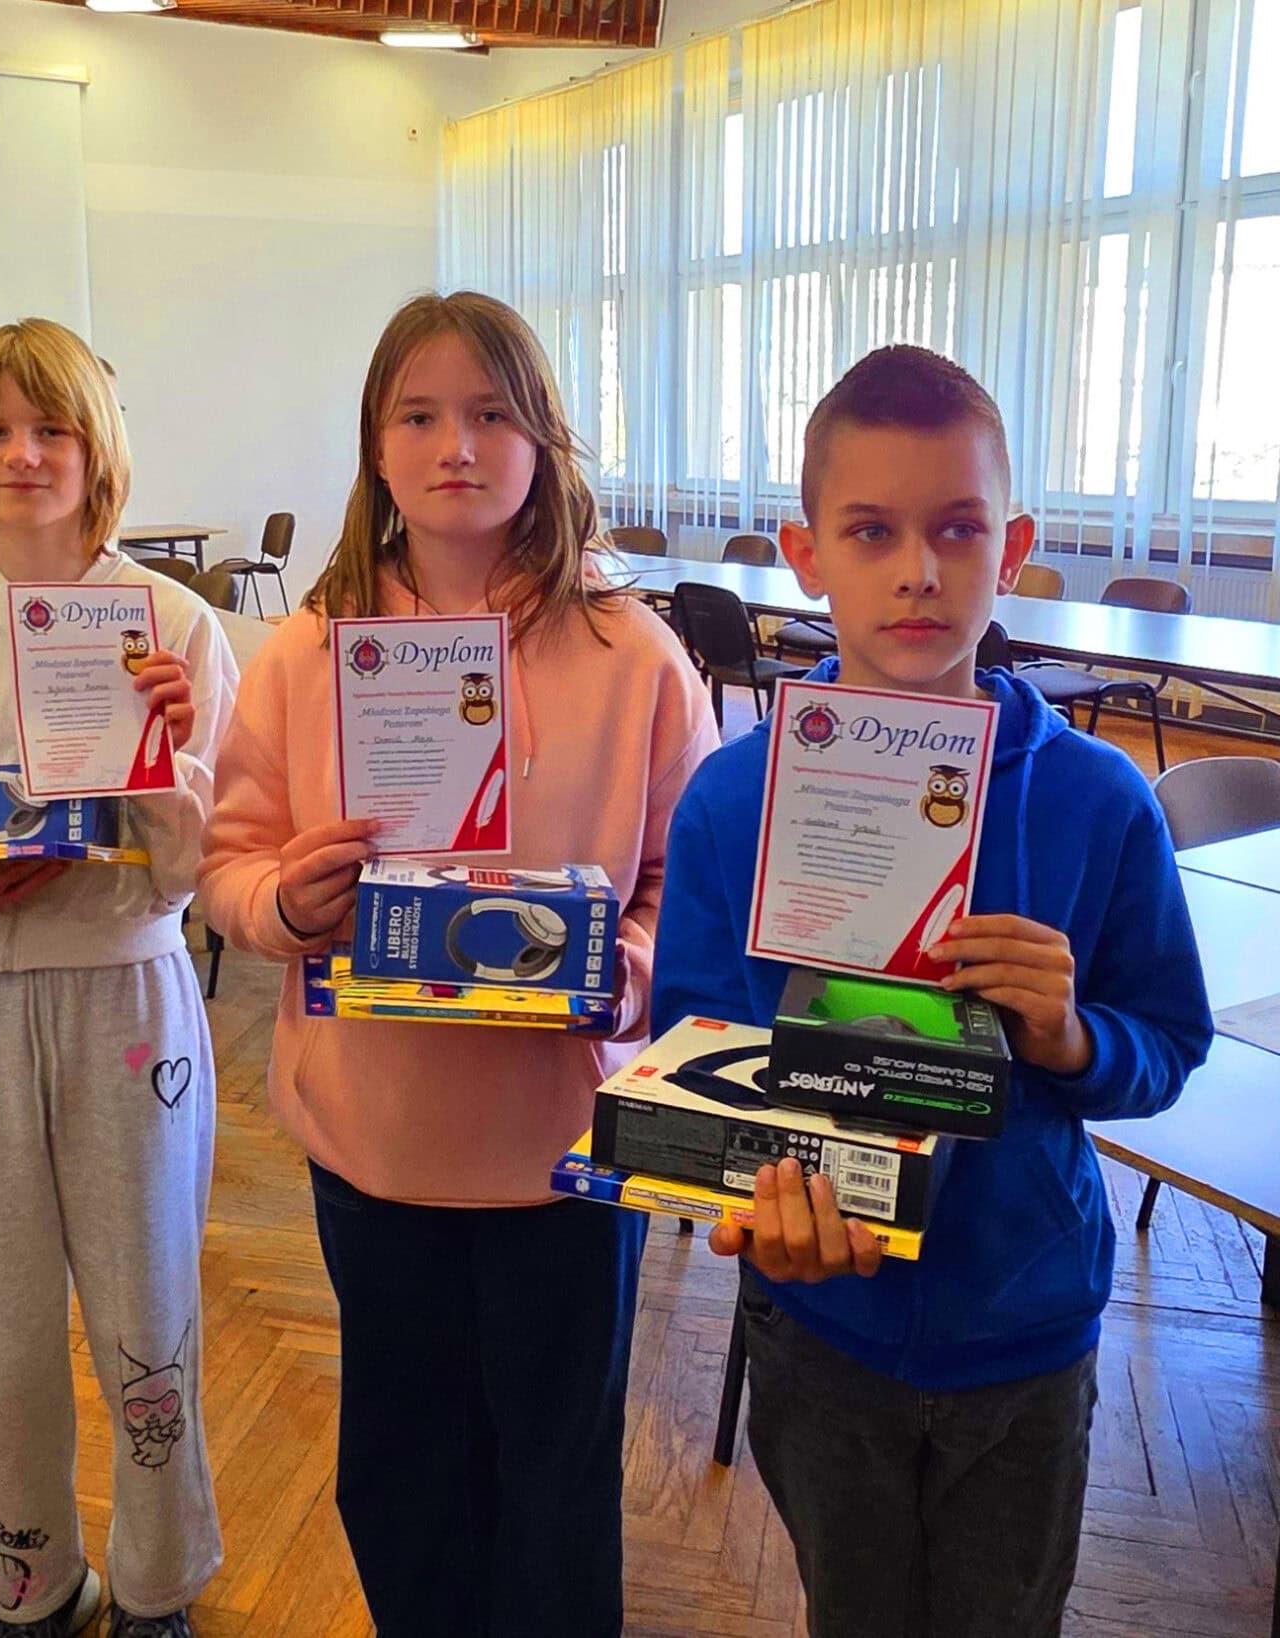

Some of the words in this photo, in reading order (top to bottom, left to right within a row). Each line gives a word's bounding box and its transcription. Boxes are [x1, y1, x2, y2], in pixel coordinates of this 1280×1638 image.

[61, 599, 146, 629] Dyplom
[393, 636, 495, 673] Dyplom
[849, 715, 977, 758] Dyplom
[386, 906, 403, 959] LIBERO
[863, 1065, 913, 1081] OPTICAL
[872, 1055, 917, 1071] MOUSE
[917, 1062, 966, 1078] GAMING
[778, 1071, 875, 1098] ANTEROS
